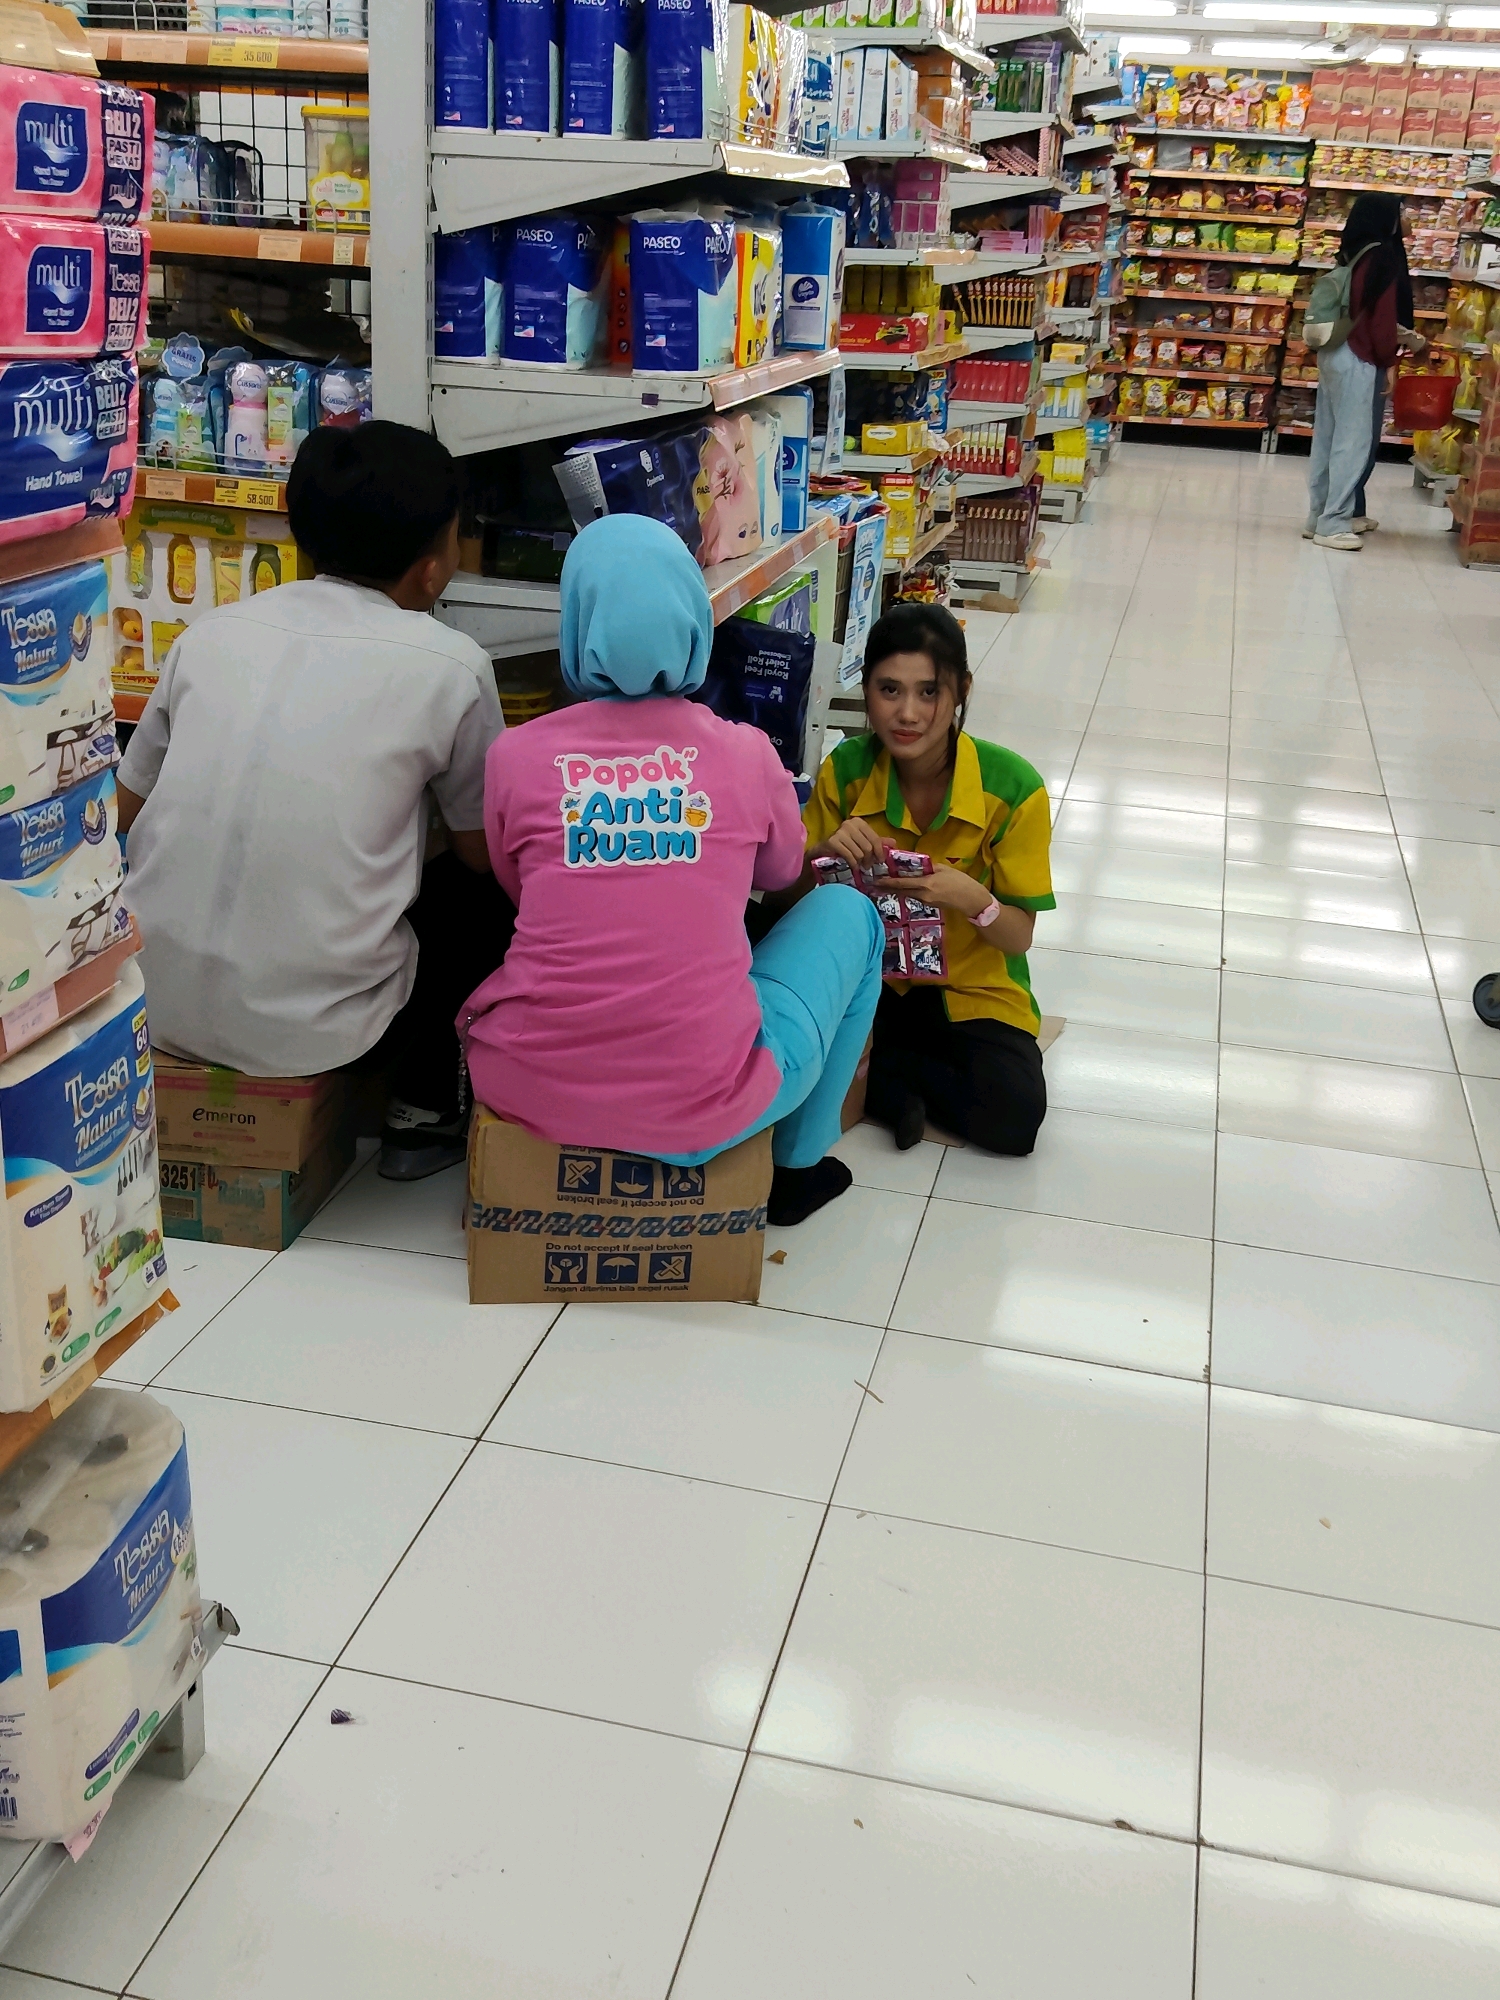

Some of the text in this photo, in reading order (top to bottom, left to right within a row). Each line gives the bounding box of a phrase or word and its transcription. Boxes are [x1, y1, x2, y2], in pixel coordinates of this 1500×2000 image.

[24, 112, 74, 147] multi
[109, 140, 140, 155] PASTI
[516, 228, 554, 242] PASEO
[643, 236, 681, 249] PASEO
[110, 241, 140, 253] HEMAT
[36, 254, 81, 287] multi
[109, 263, 141, 293] Tessa
[109, 324, 134, 337] PASTI
[236, 379, 262, 390] Cussons
[13, 379, 93, 438] multi
[100, 410, 126, 425] PASTI
[25, 466, 84, 492] Hand Towel
[1, 606, 57, 650] Tessa
[747, 655, 791, 670] Toilet Roll
[765, 668, 790, 680] Royal
[580, 786, 684, 826] Anti
[12, 801, 66, 847] Tessa
[568, 825, 697, 864] Ruam
[136, 1030, 148, 1051] 60
[64, 1056, 130, 1128] Tessa
[192, 1107, 257, 1125] emeron
[160, 1163, 196, 1192] 3251
[556, 1193, 705, 1208] Do not accept if seal broken
[545, 1242, 693, 1252] Do not accept if seal broken
[543, 1285, 578, 1293] Jangan
[579, 1284, 617, 1292] diterima
[663, 1284, 690, 1292] rusak
[113, 1509, 170, 1598] Tessa
